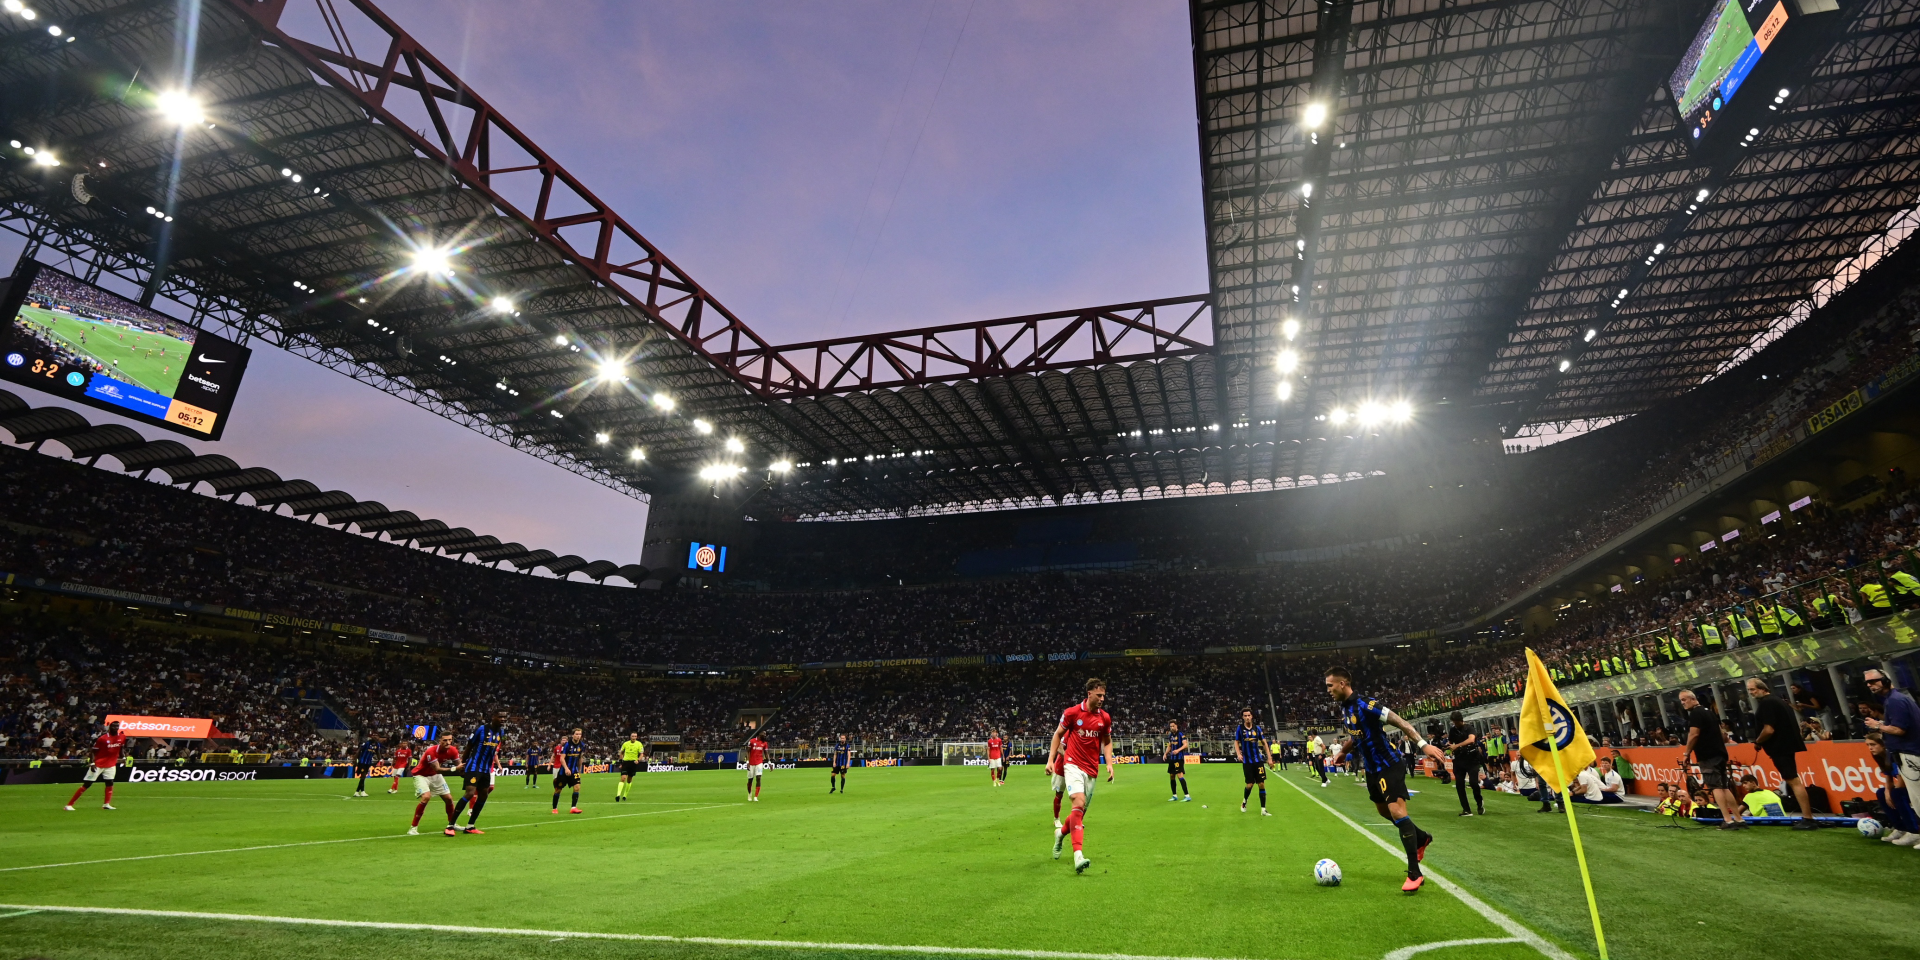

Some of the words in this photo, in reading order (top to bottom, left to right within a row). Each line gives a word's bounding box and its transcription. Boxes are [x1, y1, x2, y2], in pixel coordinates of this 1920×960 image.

[31, 358, 59, 379] 3-2
[188, 373, 220, 391] betsson
[178, 411, 204, 426] 05:12
[61, 582, 87, 593] CENTRO
[87, 586, 139, 602] COORDINAMENTO
[139, 593, 156, 603] INTER
[156, 596, 172, 605] CLUB
[224, 607, 261, 621] SAVONA
[266, 614, 323, 630] ESSLINGEN
[881, 658, 928, 668] VICENTINO
[947, 655, 985, 665] AMBROSIANA
[119, 720, 197, 733] betsson.sport
[866, 759, 897, 767] betsson
[1112, 755, 1140, 764] etsson
[129, 765, 257, 783] betsson.sport
[583, 764, 610, 774] betsson
[647, 763, 688, 772] betsson.sport
